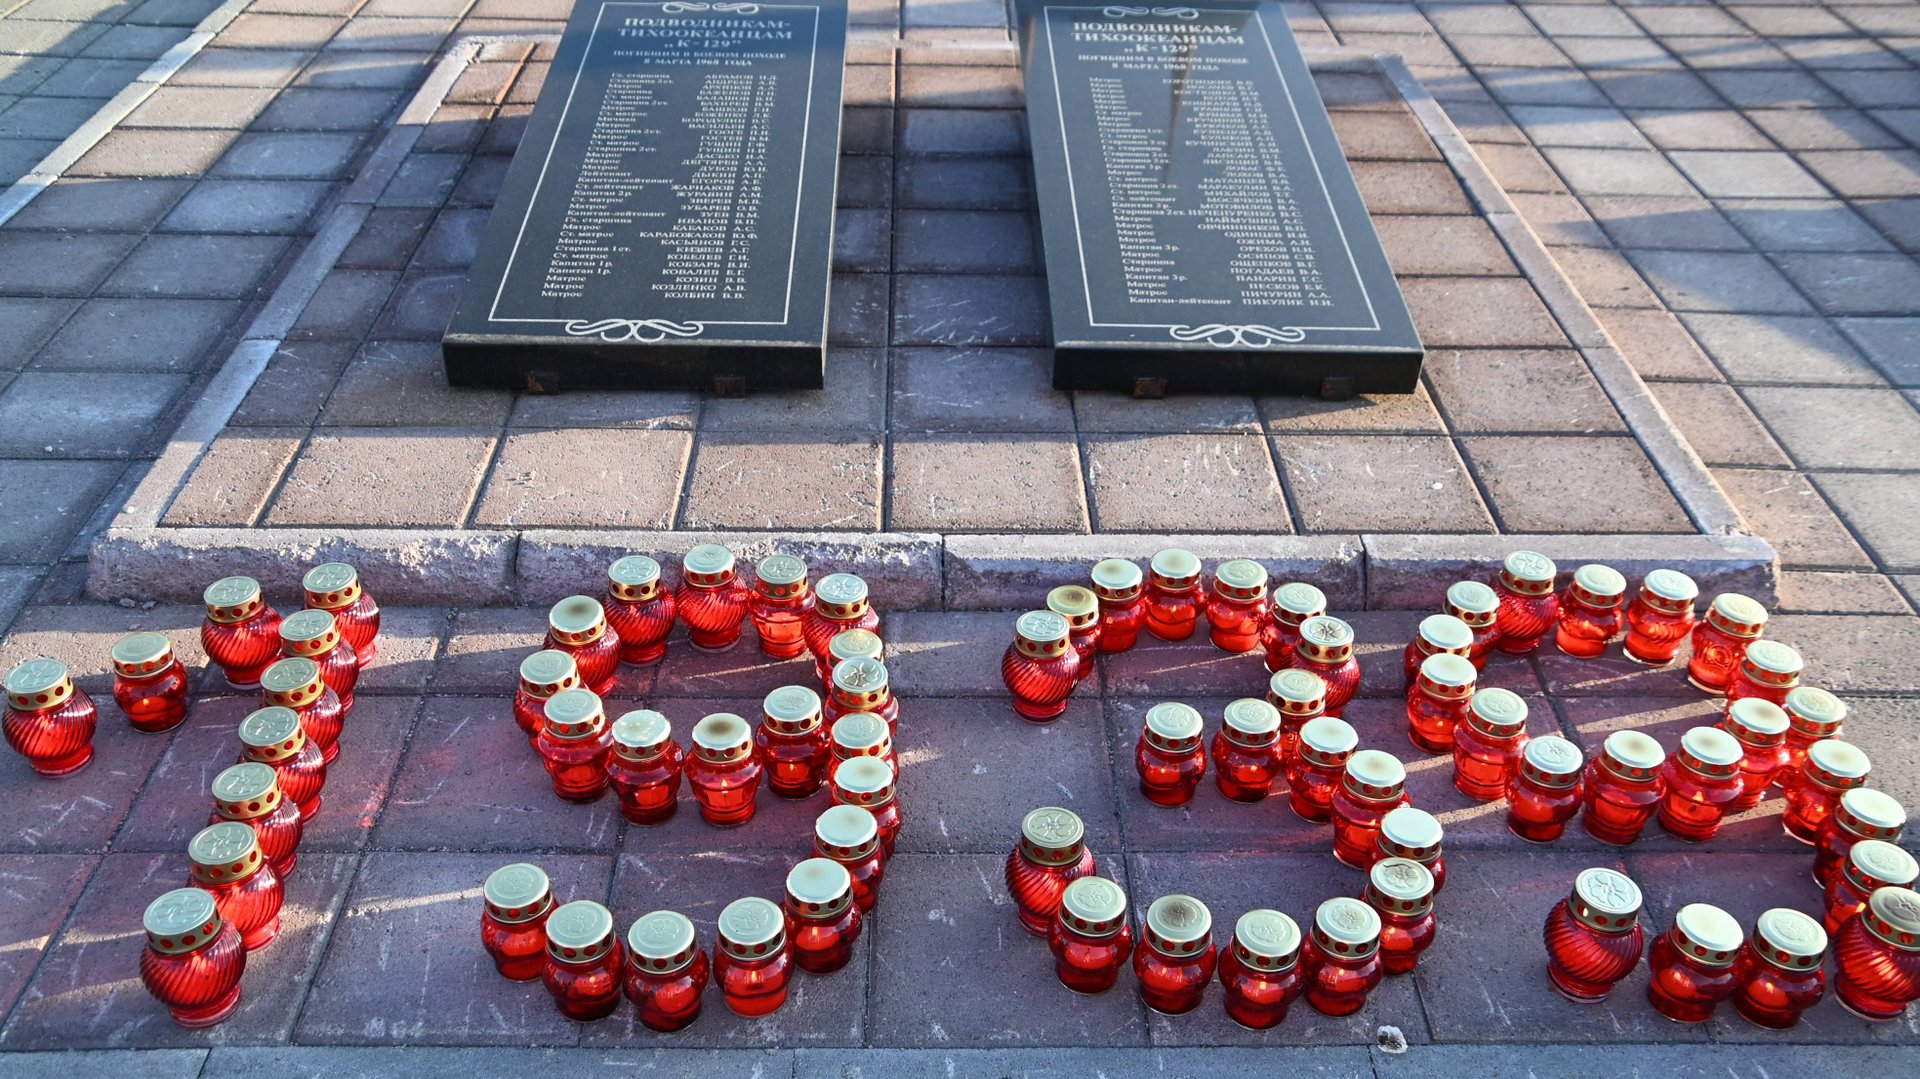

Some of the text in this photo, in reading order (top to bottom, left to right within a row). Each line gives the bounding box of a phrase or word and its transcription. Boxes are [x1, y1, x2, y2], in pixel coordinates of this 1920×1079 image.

[623, 17, 791, 28] ПОДВОДНИКАМ-
[1073, 21, 1239, 33] ПОДВОДНИКАМ-
[615, 28, 792, 40] ТИХООКЕАНЦАМ
[1070, 32, 1245, 45] ТИХООКЕАНЦАМ
